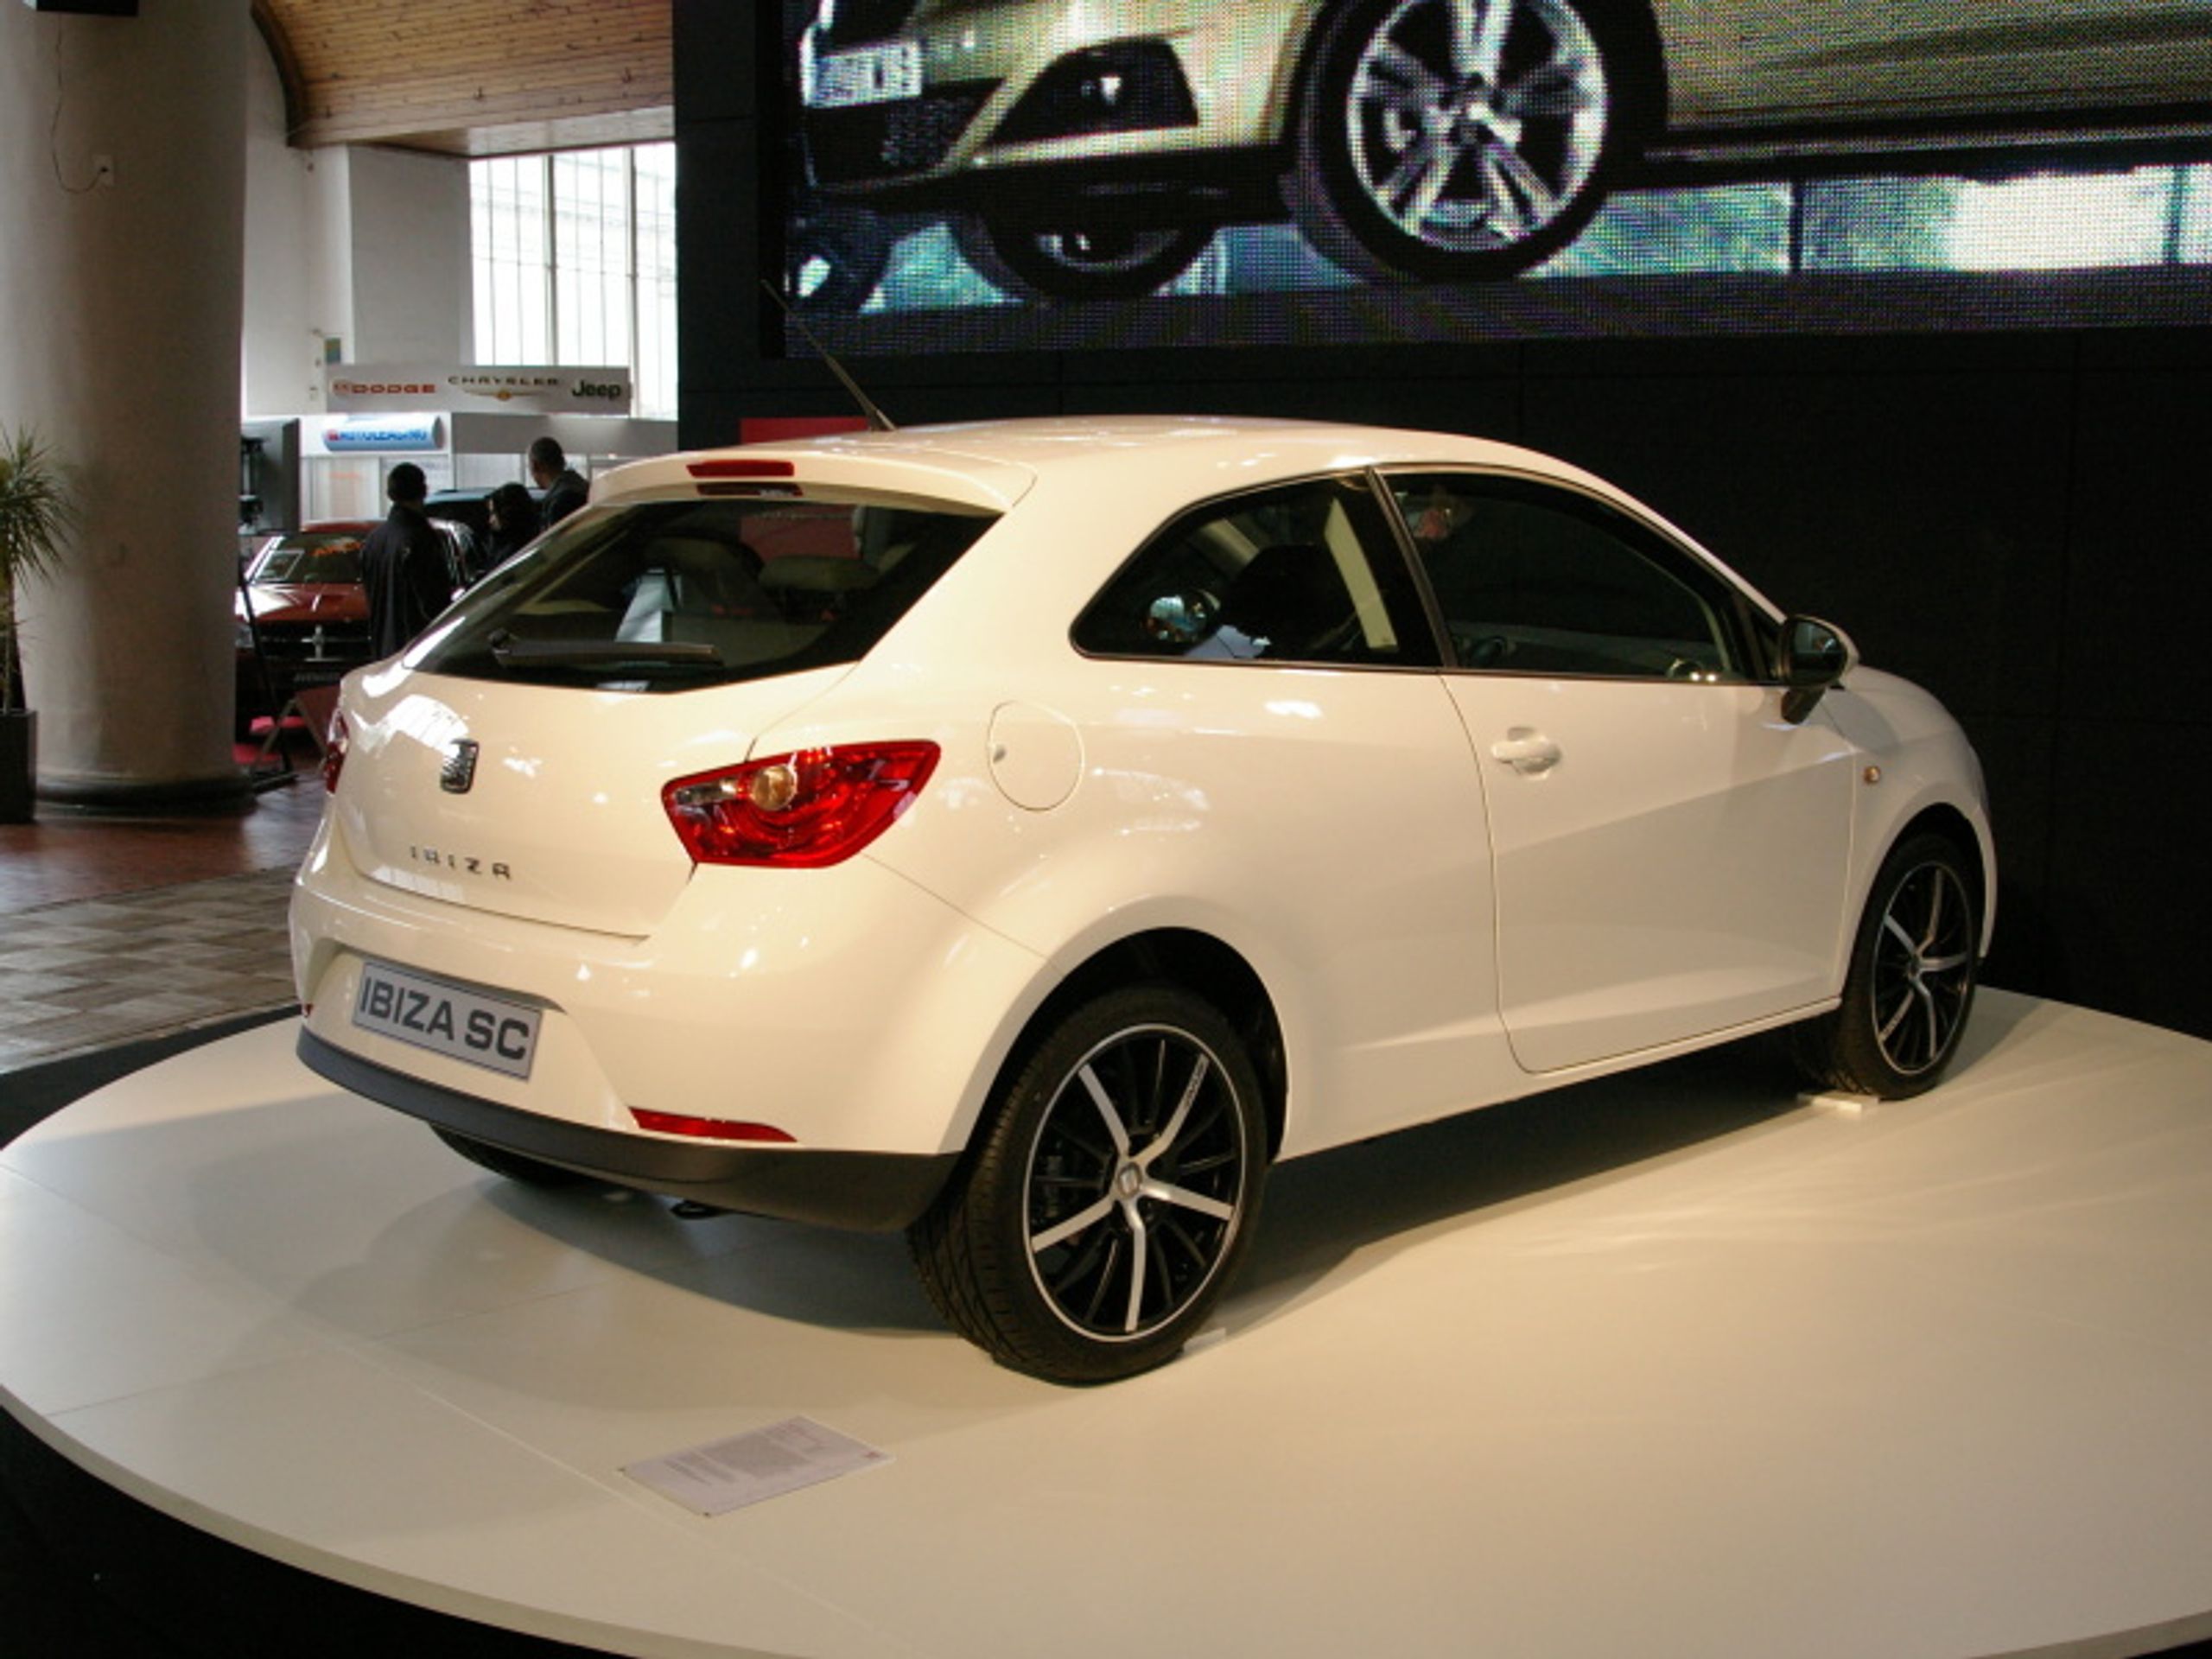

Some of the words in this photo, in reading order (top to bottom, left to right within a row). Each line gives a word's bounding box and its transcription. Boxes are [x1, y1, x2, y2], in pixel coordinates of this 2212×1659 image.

[351, 384, 435, 394] DODGE
[572, 379, 621, 400] Jeep
[410, 846, 511, 880] IBIZA
[359, 977, 454, 1041] IBIZA
[464, 1009, 530, 1060] SC
